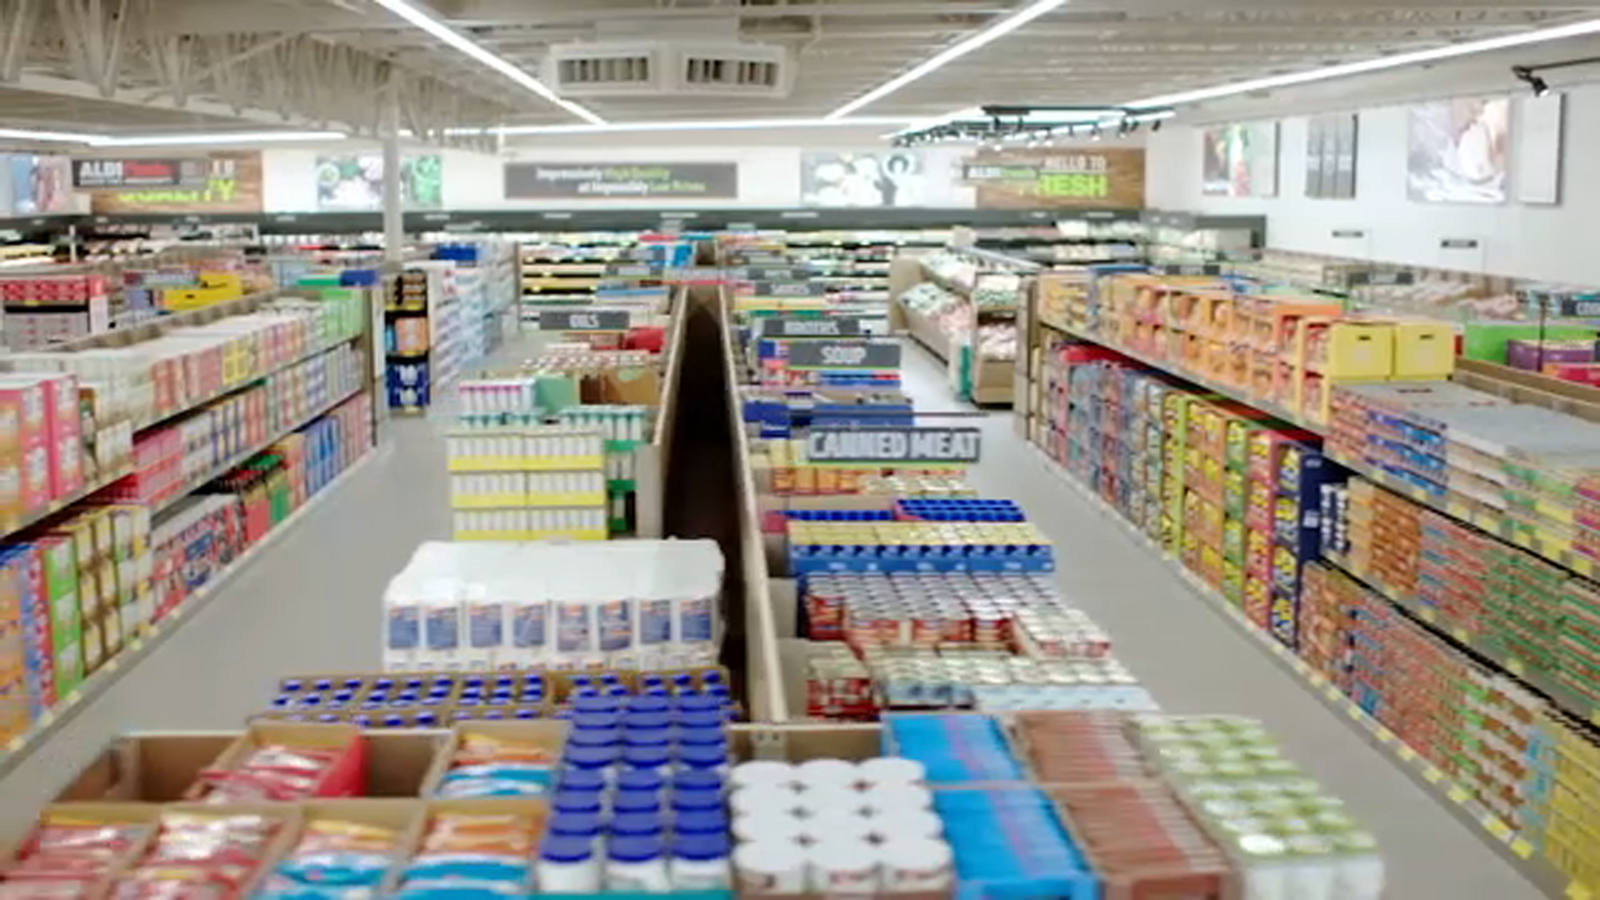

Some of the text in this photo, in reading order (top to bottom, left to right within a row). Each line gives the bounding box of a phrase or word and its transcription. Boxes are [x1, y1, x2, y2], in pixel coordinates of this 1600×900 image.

[80, 160, 123, 177] ALDI
[569, 313, 599, 328] OILS
[821, 346, 867, 365] SOUP
[809, 430, 980, 460] CANNED MEAT
